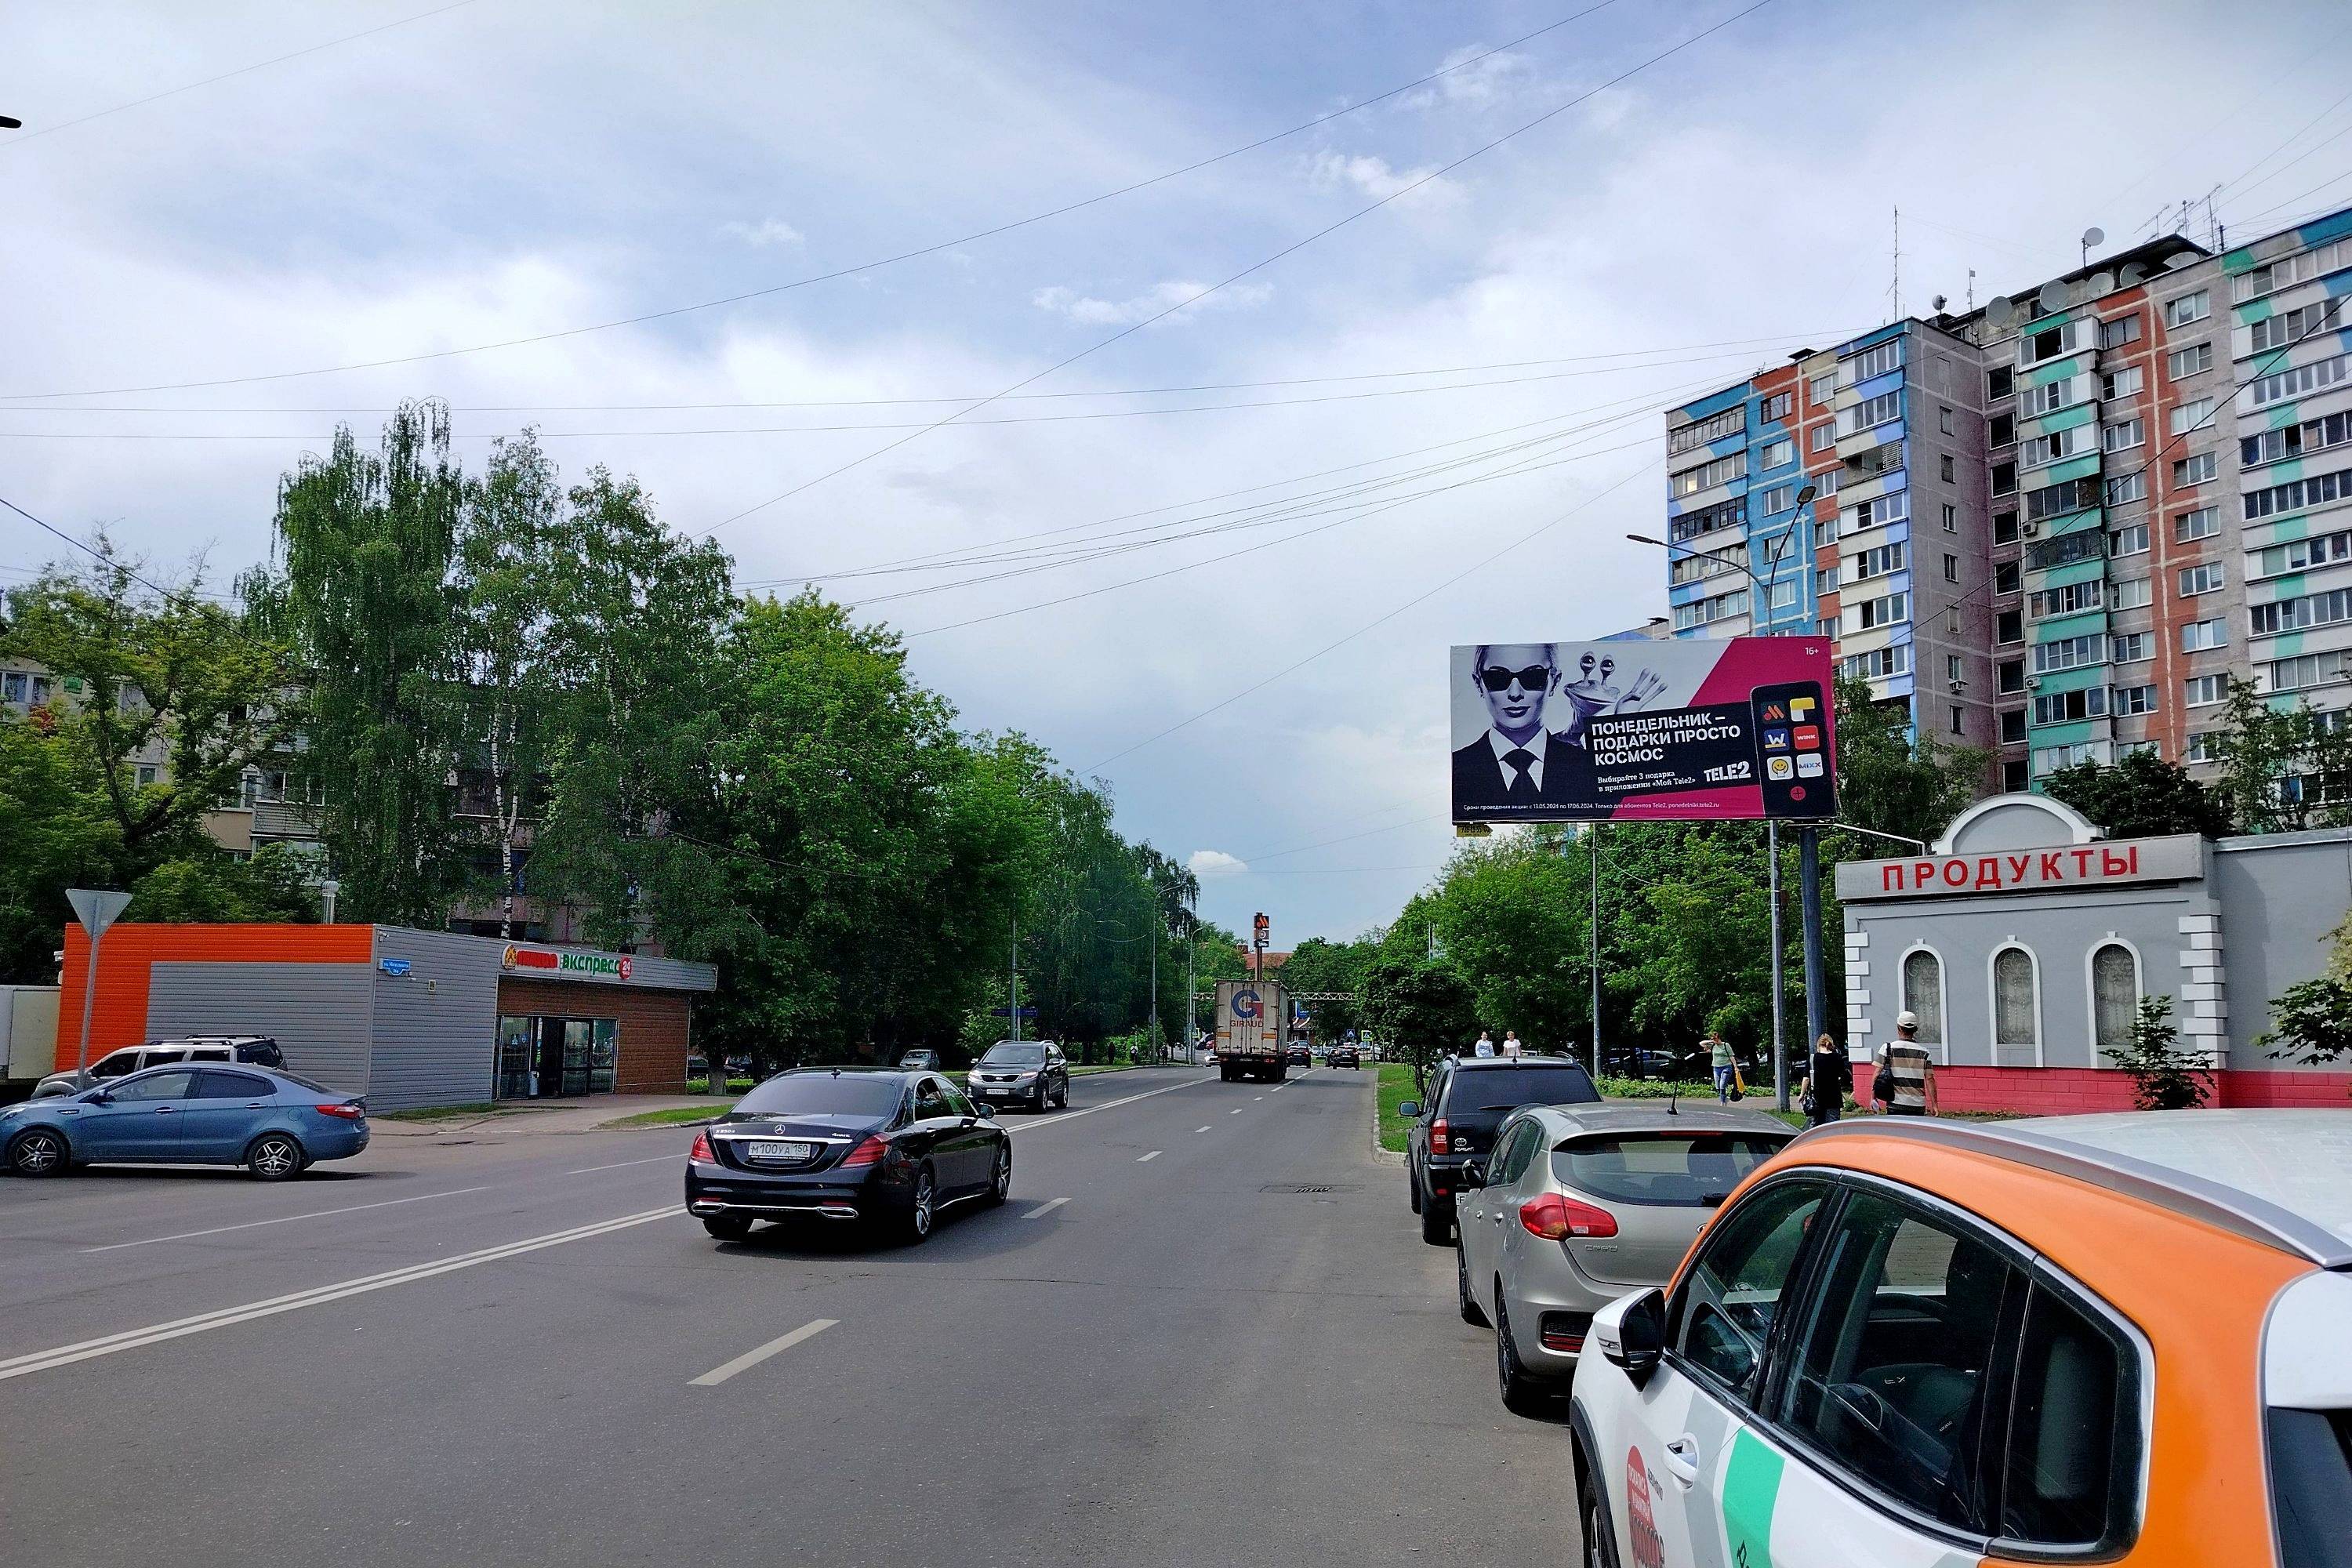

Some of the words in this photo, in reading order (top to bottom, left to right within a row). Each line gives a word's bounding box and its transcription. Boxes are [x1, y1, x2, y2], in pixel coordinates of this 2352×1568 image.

[1805, 647, 1820, 655] 16+
[1592, 713, 1712, 736] ПОНЕДЕЛЬНИК
[1593, 731, 1671, 751] ПОДАРКИ
[1675, 724, 1740, 743] ПРОСТО
[1595, 747, 1664, 766] КОСМОС
[1597, 775, 1638, 785] Выбирайте
[1645, 771, 1675, 780] подарка
[1704, 760, 1751, 782] TELE2
[1605, 782, 1651, 792] приложении
[1882, 846, 2137, 891] ПРОДУКТЫ
[562, 953, 620, 975] экспресс
[622, 960, 631, 971] 24
